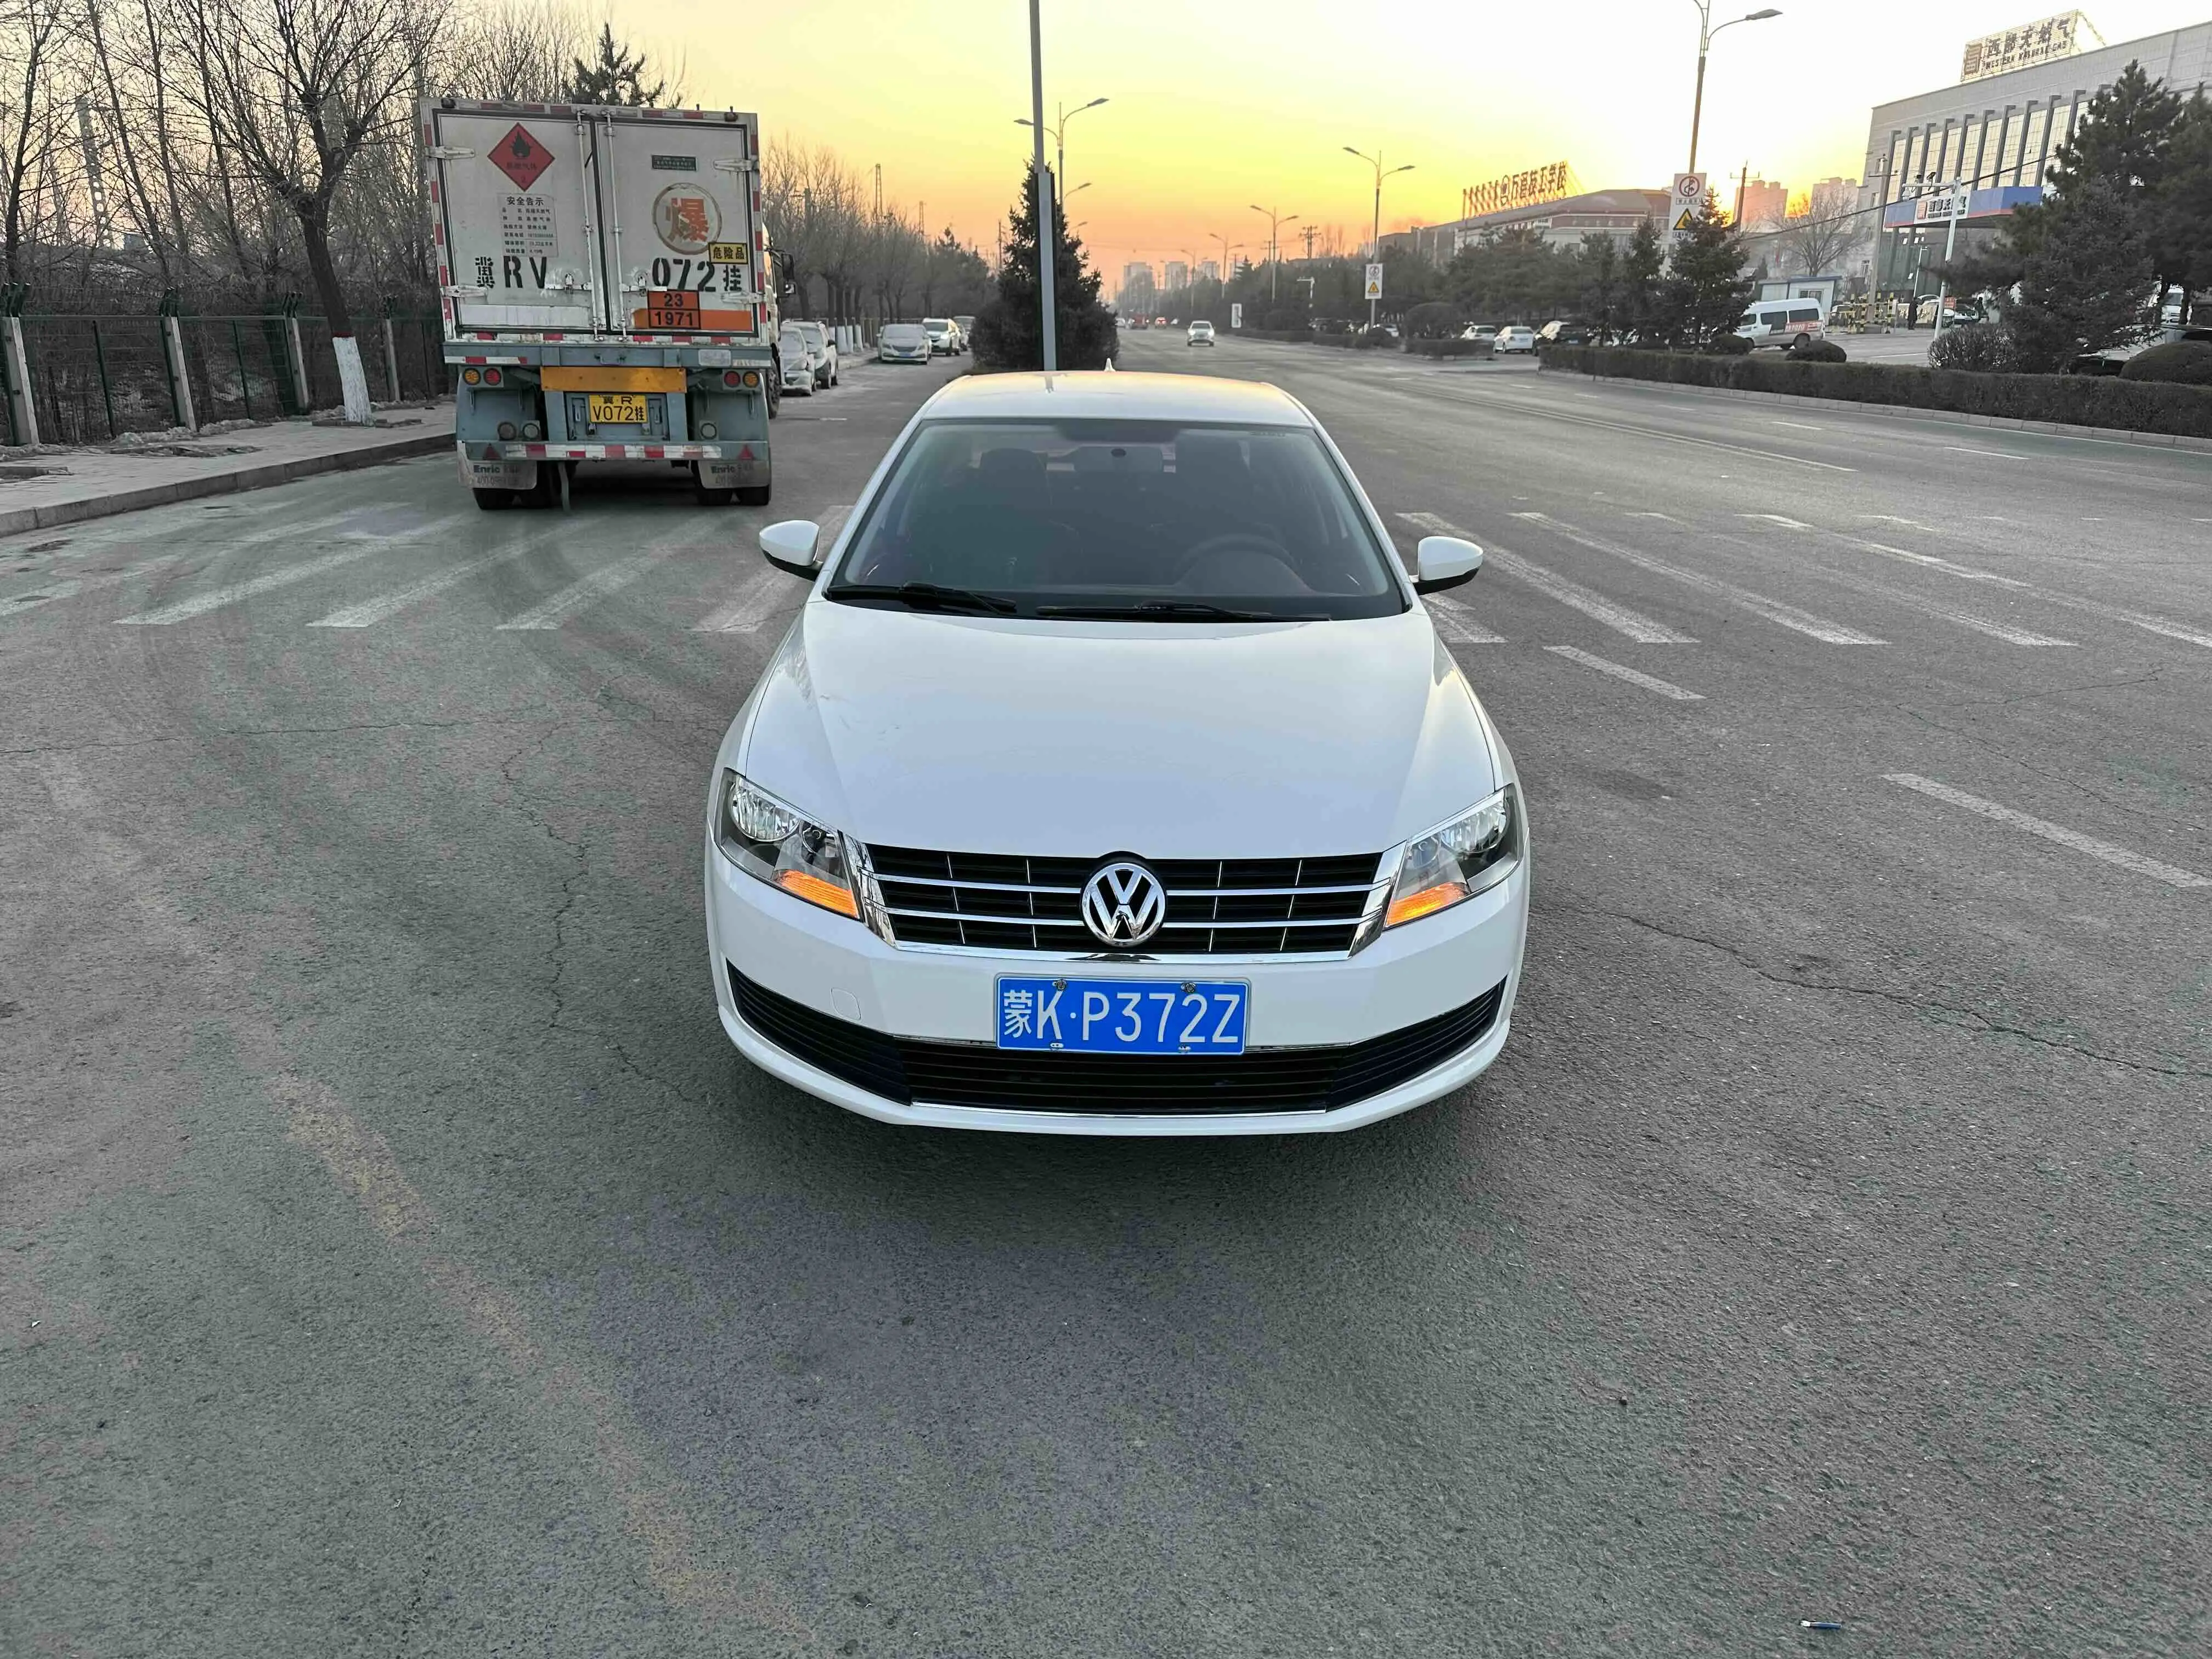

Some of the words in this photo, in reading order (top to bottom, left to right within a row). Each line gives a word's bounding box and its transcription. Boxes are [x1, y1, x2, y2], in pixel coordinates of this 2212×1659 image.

[507, 196, 544, 206] 安全告示
[665, 198, 709, 242] 爆
[664, 293, 684, 307] 23
[654, 312, 693, 326] 1971
[592, 405, 645, 421] V072挂
[473, 464, 500, 473] Enric
[710, 464, 736, 474] Enric
